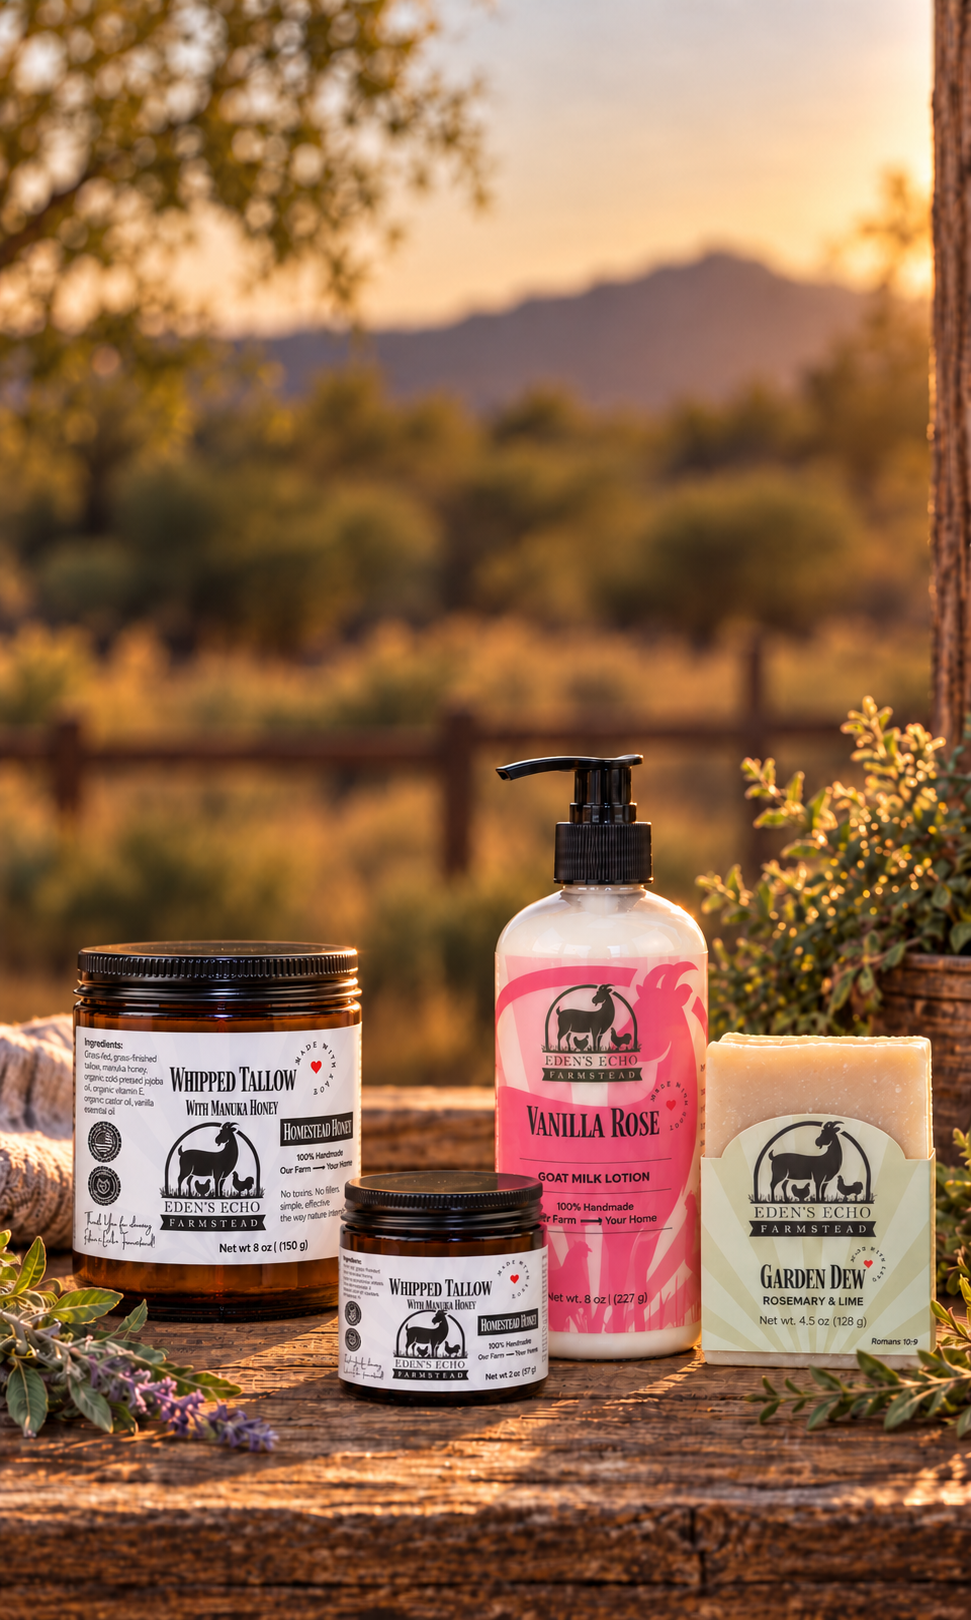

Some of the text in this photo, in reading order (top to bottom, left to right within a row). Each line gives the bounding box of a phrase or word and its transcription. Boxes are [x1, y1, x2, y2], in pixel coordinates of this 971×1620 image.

[84, 1038, 123, 1049] Ingredients:
[545, 1055, 638, 1067] EDEN'S ECHO
[169, 1066, 297, 1093] WHIPPED TALLOW
[549, 1071, 636, 1079] FARMSTEAD
[185, 1099, 279, 1116] WITH MANUKA HONEY
[527, 1105, 660, 1138] VANILLA ROSE
[283, 1122, 331, 1141] HOMESTEAD
[297, 1153, 314, 1161] 100%
[280, 1166, 293, 1174] Our
[294, 1165, 311, 1173] Farm
[538, 1172, 650, 1184] GOAT MILK LOTION
[280, 1190, 291, 1198] No
[164, 1201, 260, 1213] EDEN'S ECHO
[557, 1202, 634, 1211] 100% Handmade
[280, 1214, 291, 1222] the
[293, 1214, 306, 1222] way
[754, 1206, 871, 1219] EDEN'S ECHO
[169, 1218, 258, 1228] FARMSTEAD
[552, 1215, 577, 1225] Farm
[605, 1217, 627, 1225] Your
[629, 1215, 658, 1224] Home
[760, 1225, 867, 1234] FARMSTEAD
[219, 1243, 237, 1253] Net
[238, 1244, 251, 1252] wt
[253, 1243, 259, 1252] 8
[299, 1239, 308, 1251] g)
[760, 1264, 826, 1289] GARDEN
[830, 1264, 866, 1289] DEW
[389, 1278, 442, 1297] WHIPPED
[445, 1278, 493, 1297] TALLOW
[565, 1295, 582, 1304] wt.
[584, 1295, 591, 1304] 8
[613, 1293, 635, 1306] (227
[637, 1291, 648, 1304] g)
[763, 1296, 864, 1306] ROSEMARY & LIME
[407, 1299, 424, 1310] WITH
[454, 1299, 477, 1310] HONEY
[480, 1318, 520, 1332] HOMESTEAD
[759, 1316, 867, 1329] Net wt. 4.5 oz (128 g)
[871, 1337, 901, 1346] Romans
[435, 1360, 466, 1370] ECHO
[397, 1371, 464, 1379] FARMSTEAD
[485, 1373, 498, 1381] Net
[509, 1370, 513, 1378] 2
